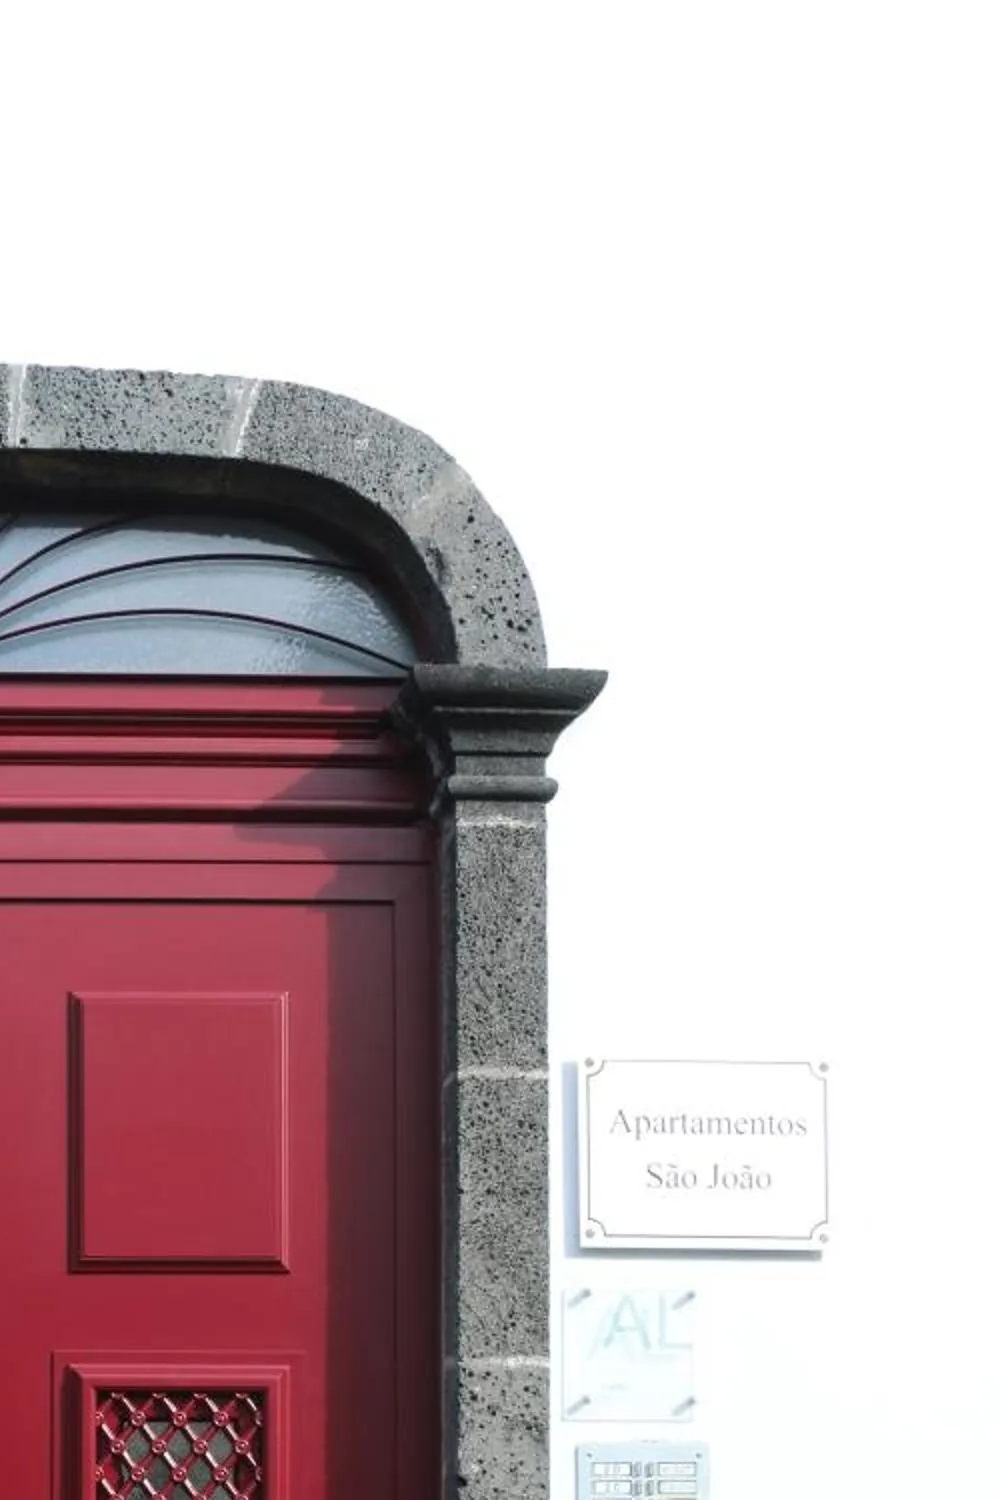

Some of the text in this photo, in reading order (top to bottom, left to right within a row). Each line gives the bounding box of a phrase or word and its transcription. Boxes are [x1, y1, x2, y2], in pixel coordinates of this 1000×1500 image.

[609, 1108, 808, 1141] Apartamentos
[646, 1162, 773, 1191] São João
[603, 1293, 693, 1350] AL
